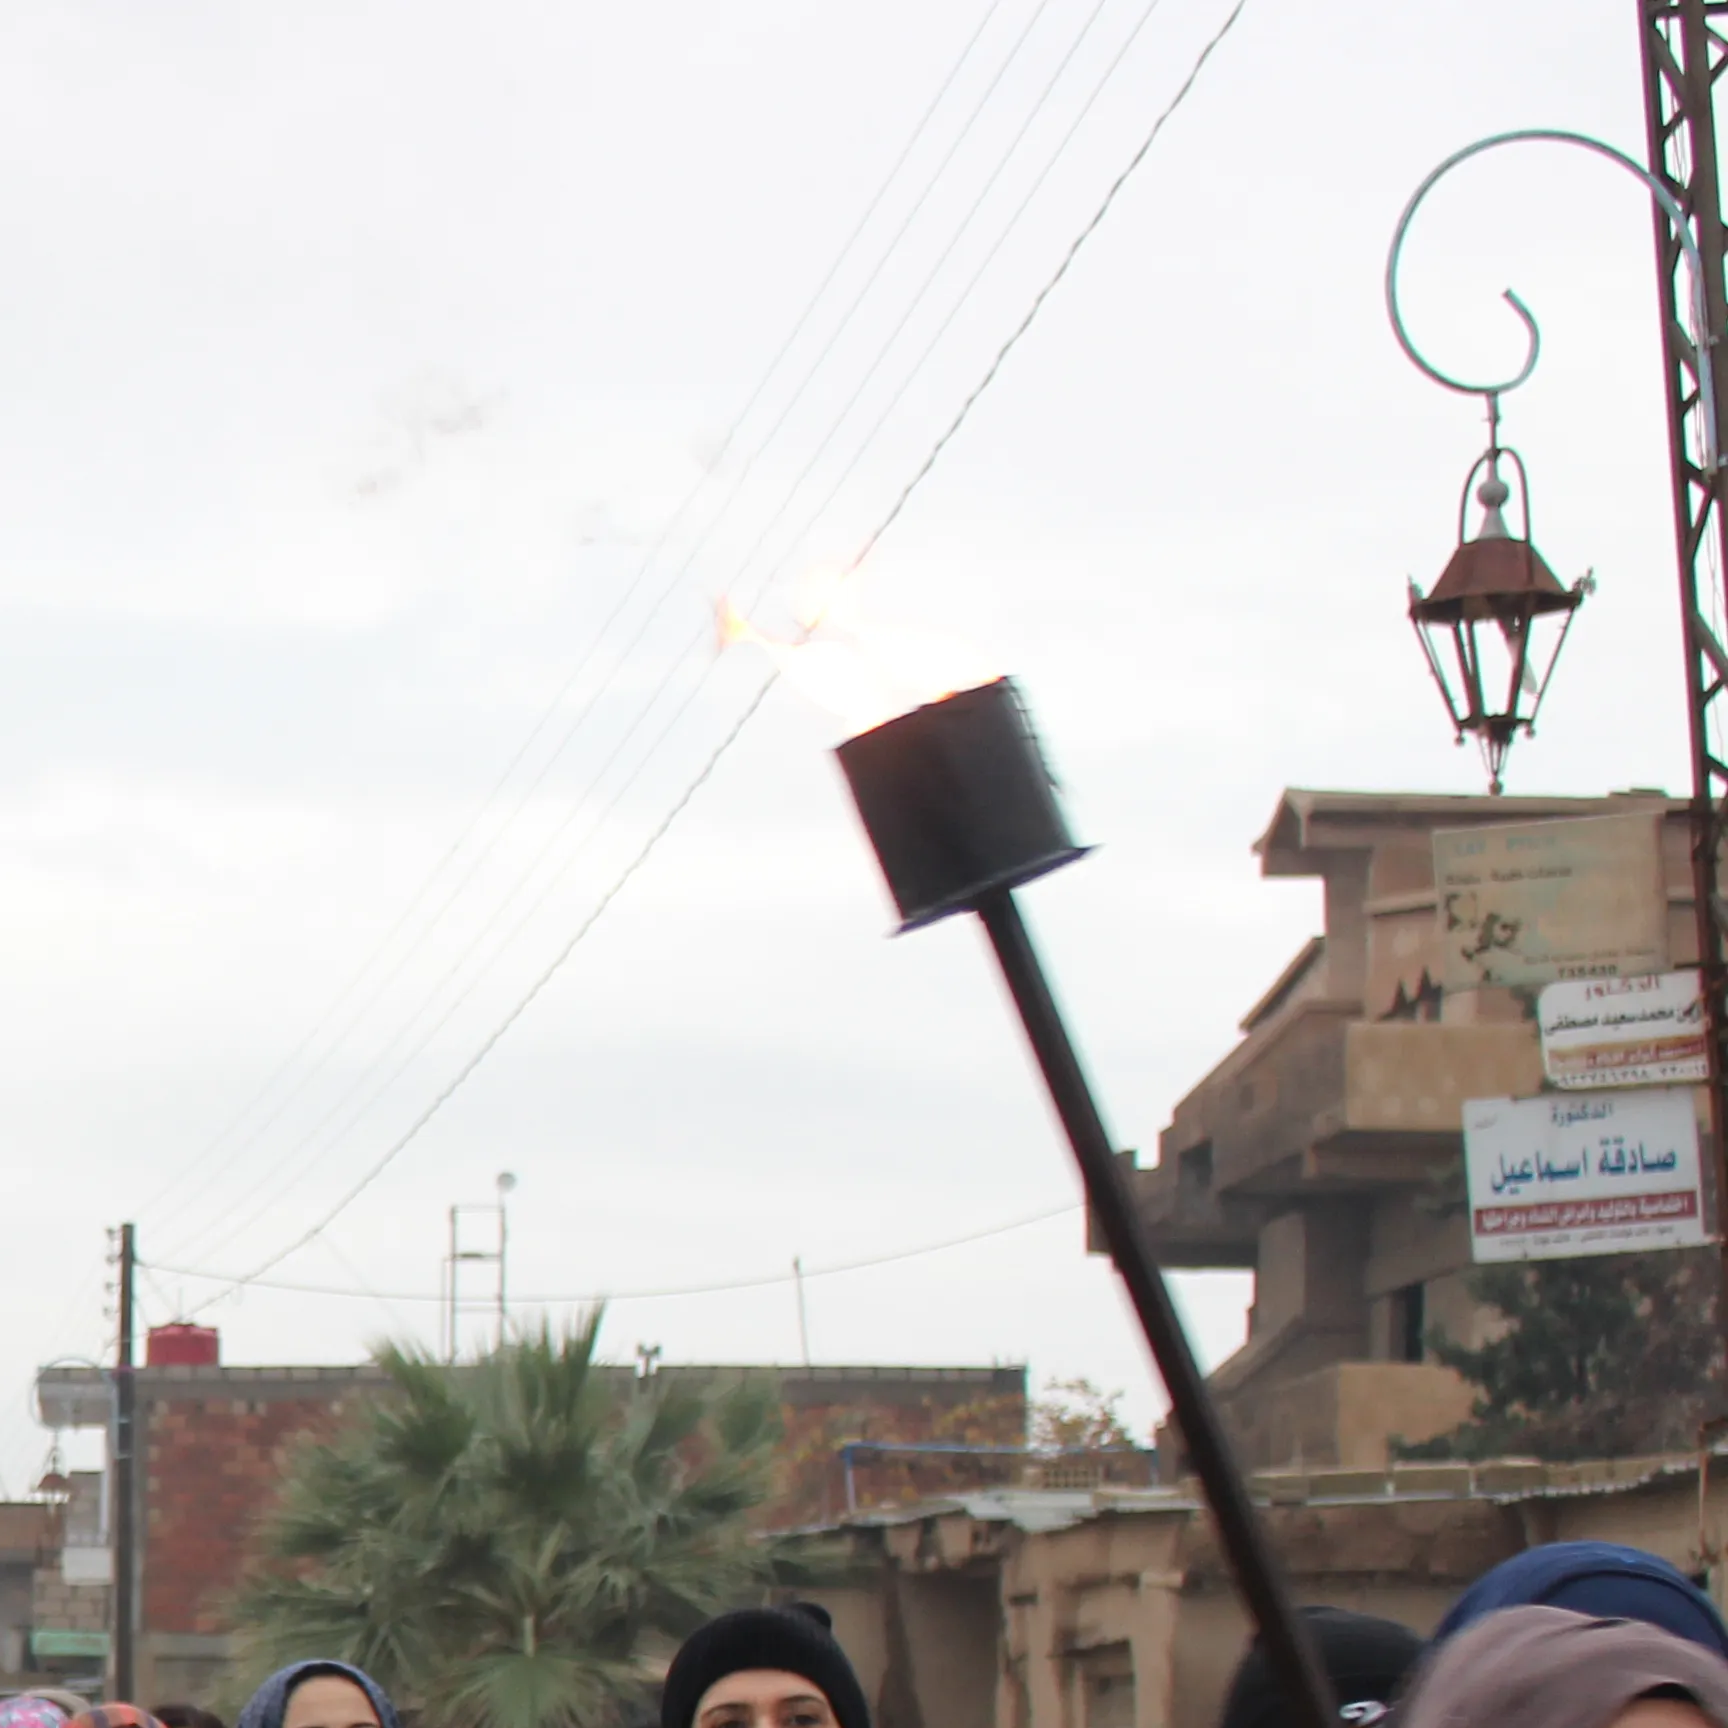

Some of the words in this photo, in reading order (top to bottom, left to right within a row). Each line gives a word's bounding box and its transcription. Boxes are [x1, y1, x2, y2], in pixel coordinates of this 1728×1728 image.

[1551, 1102, 1613, 1127] الدكتورة
[1491, 1147, 1589, 1194] اسماعيل
[1599, 1136, 1677, 1176] صادقة
